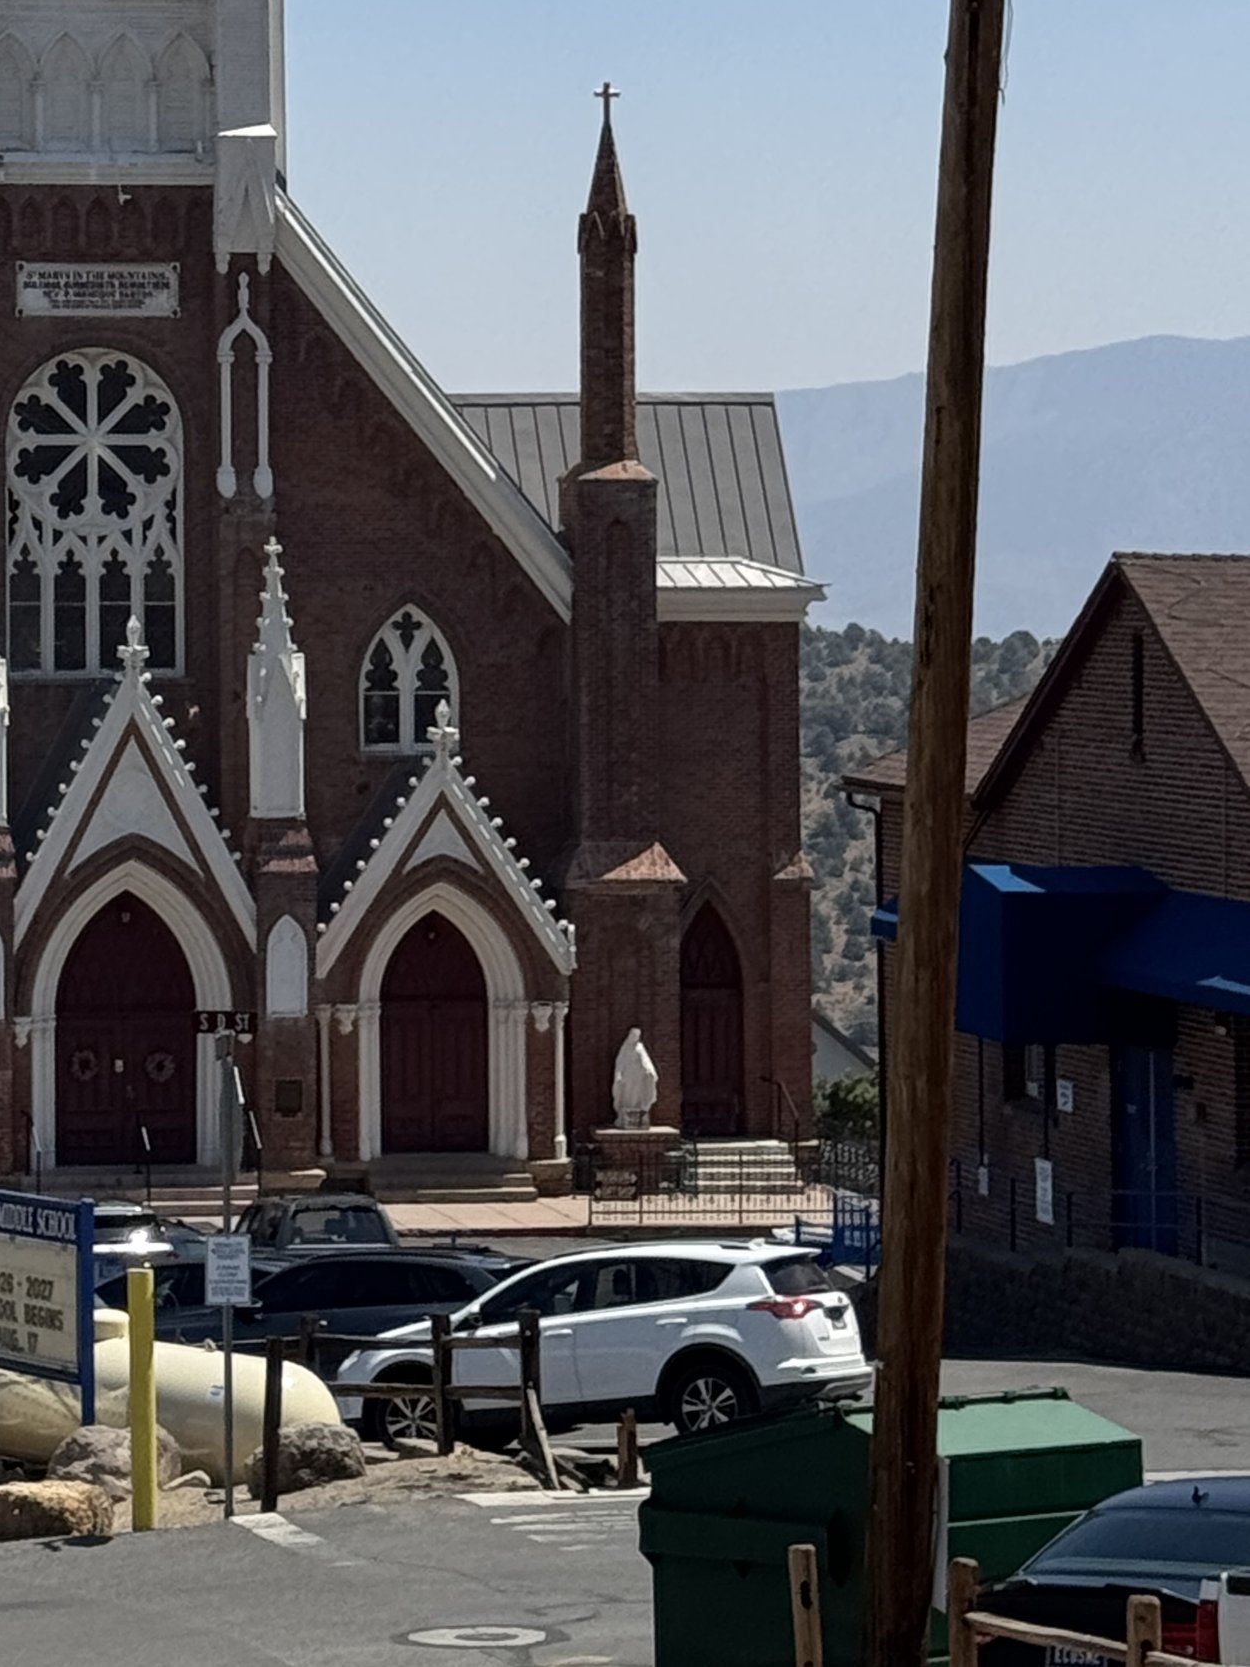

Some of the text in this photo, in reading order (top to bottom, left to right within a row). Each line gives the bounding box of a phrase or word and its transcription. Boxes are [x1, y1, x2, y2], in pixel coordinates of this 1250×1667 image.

[199, 1014, 250, 1031] S D ST
[36, 1207, 77, 1240] SCHOOL
[25, 1274, 54, 1301] 2027
[24, 1302, 64, 1332] BEGINS
